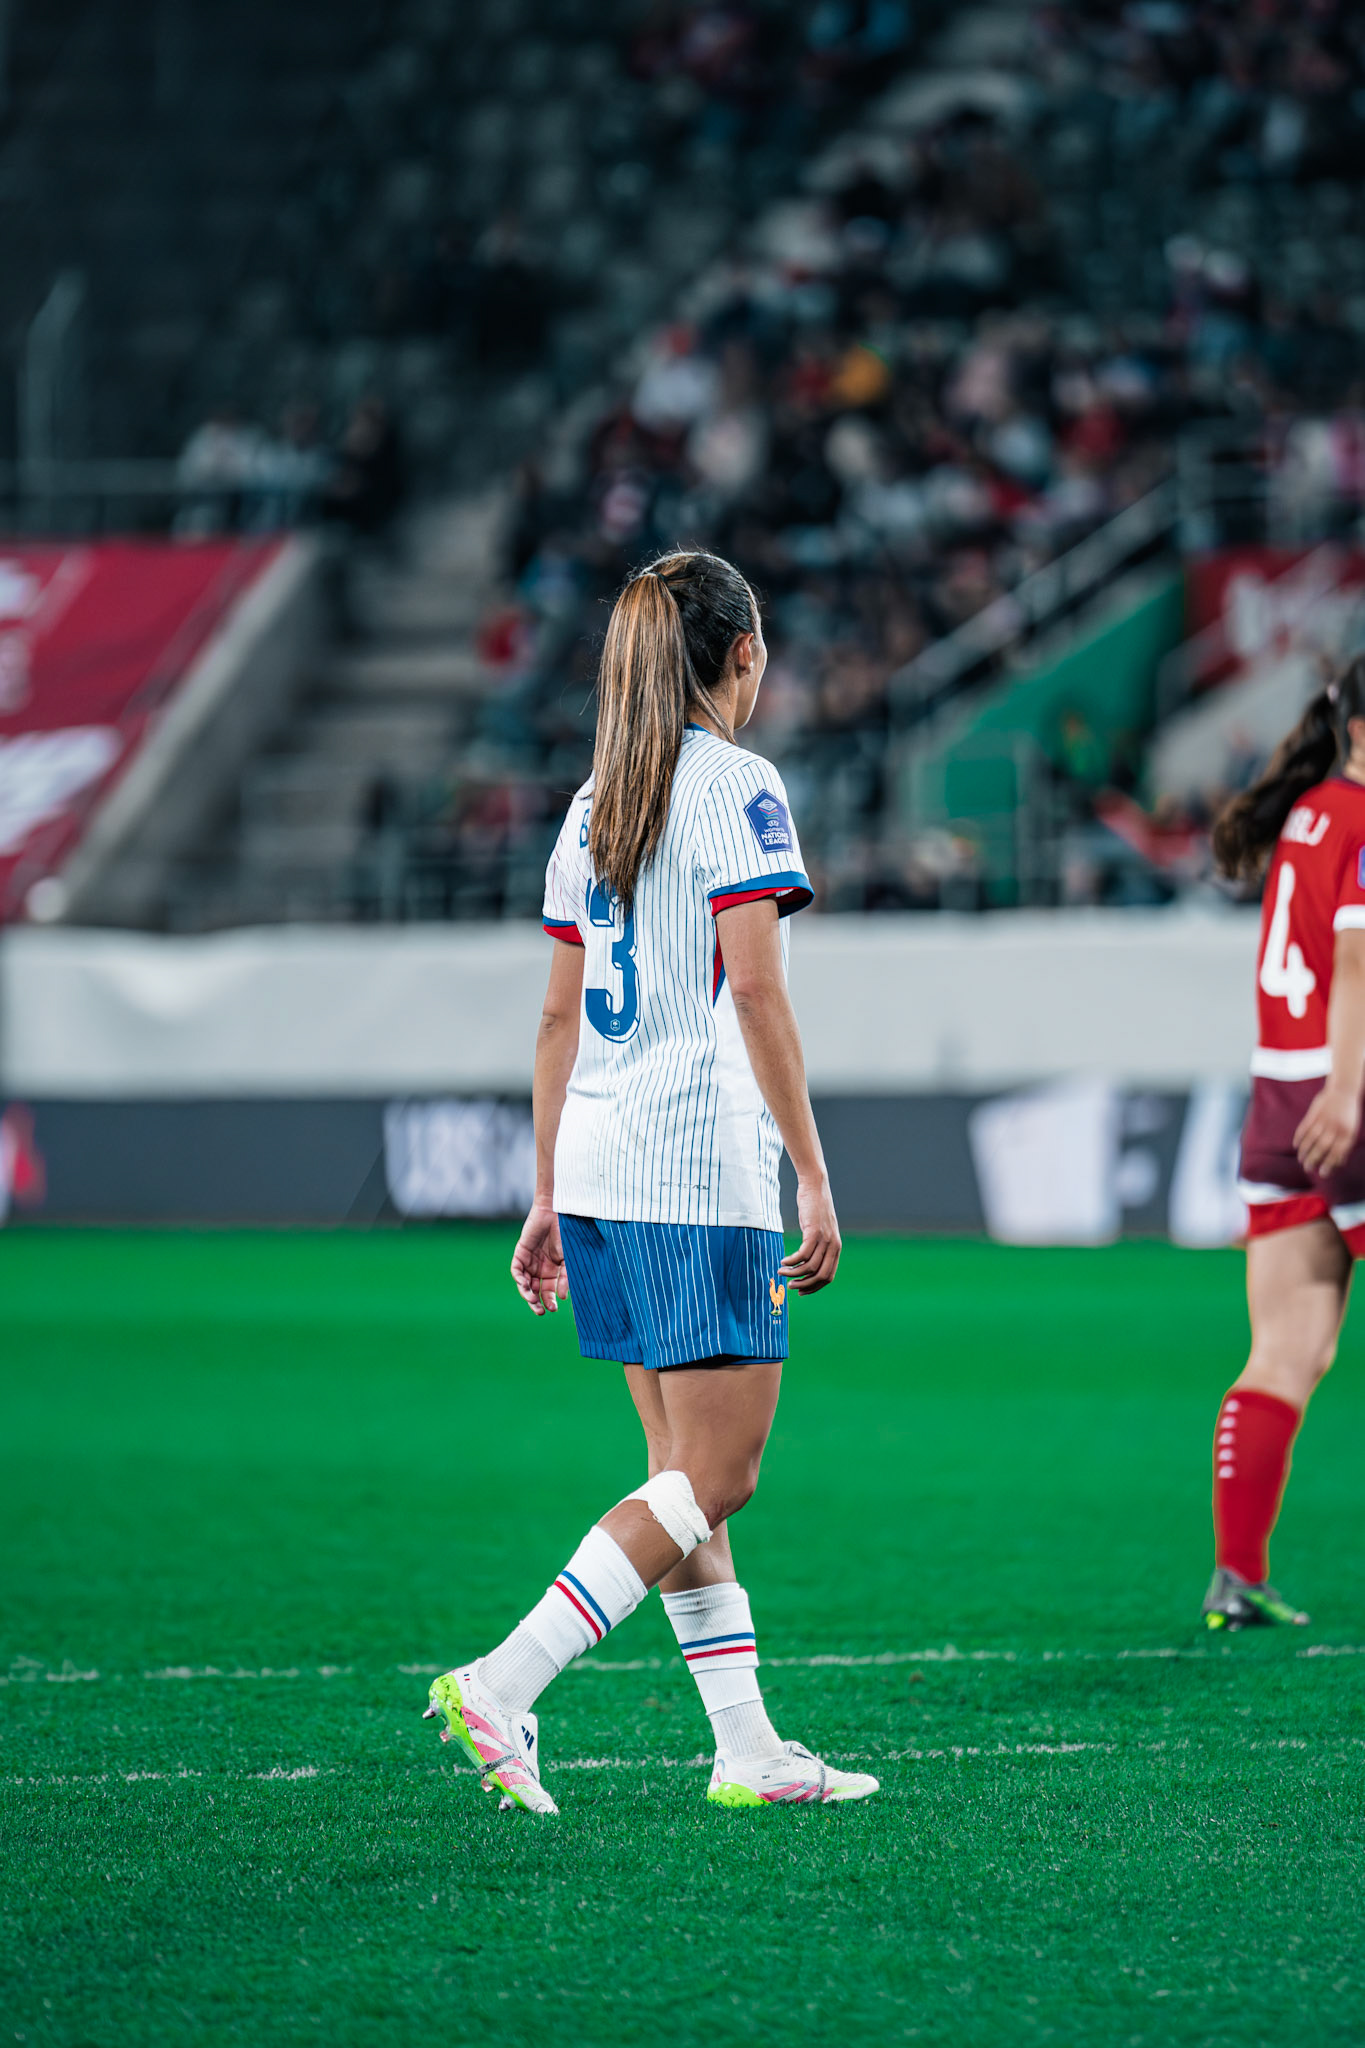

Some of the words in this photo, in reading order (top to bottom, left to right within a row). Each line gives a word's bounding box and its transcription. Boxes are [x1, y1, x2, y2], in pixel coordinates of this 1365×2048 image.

[761, 831, 789, 840] NATIONS
[764, 837, 789, 845] LEAGUE
[585, 878, 641, 1043] 3
[1260, 860, 1316, 1018] 4
